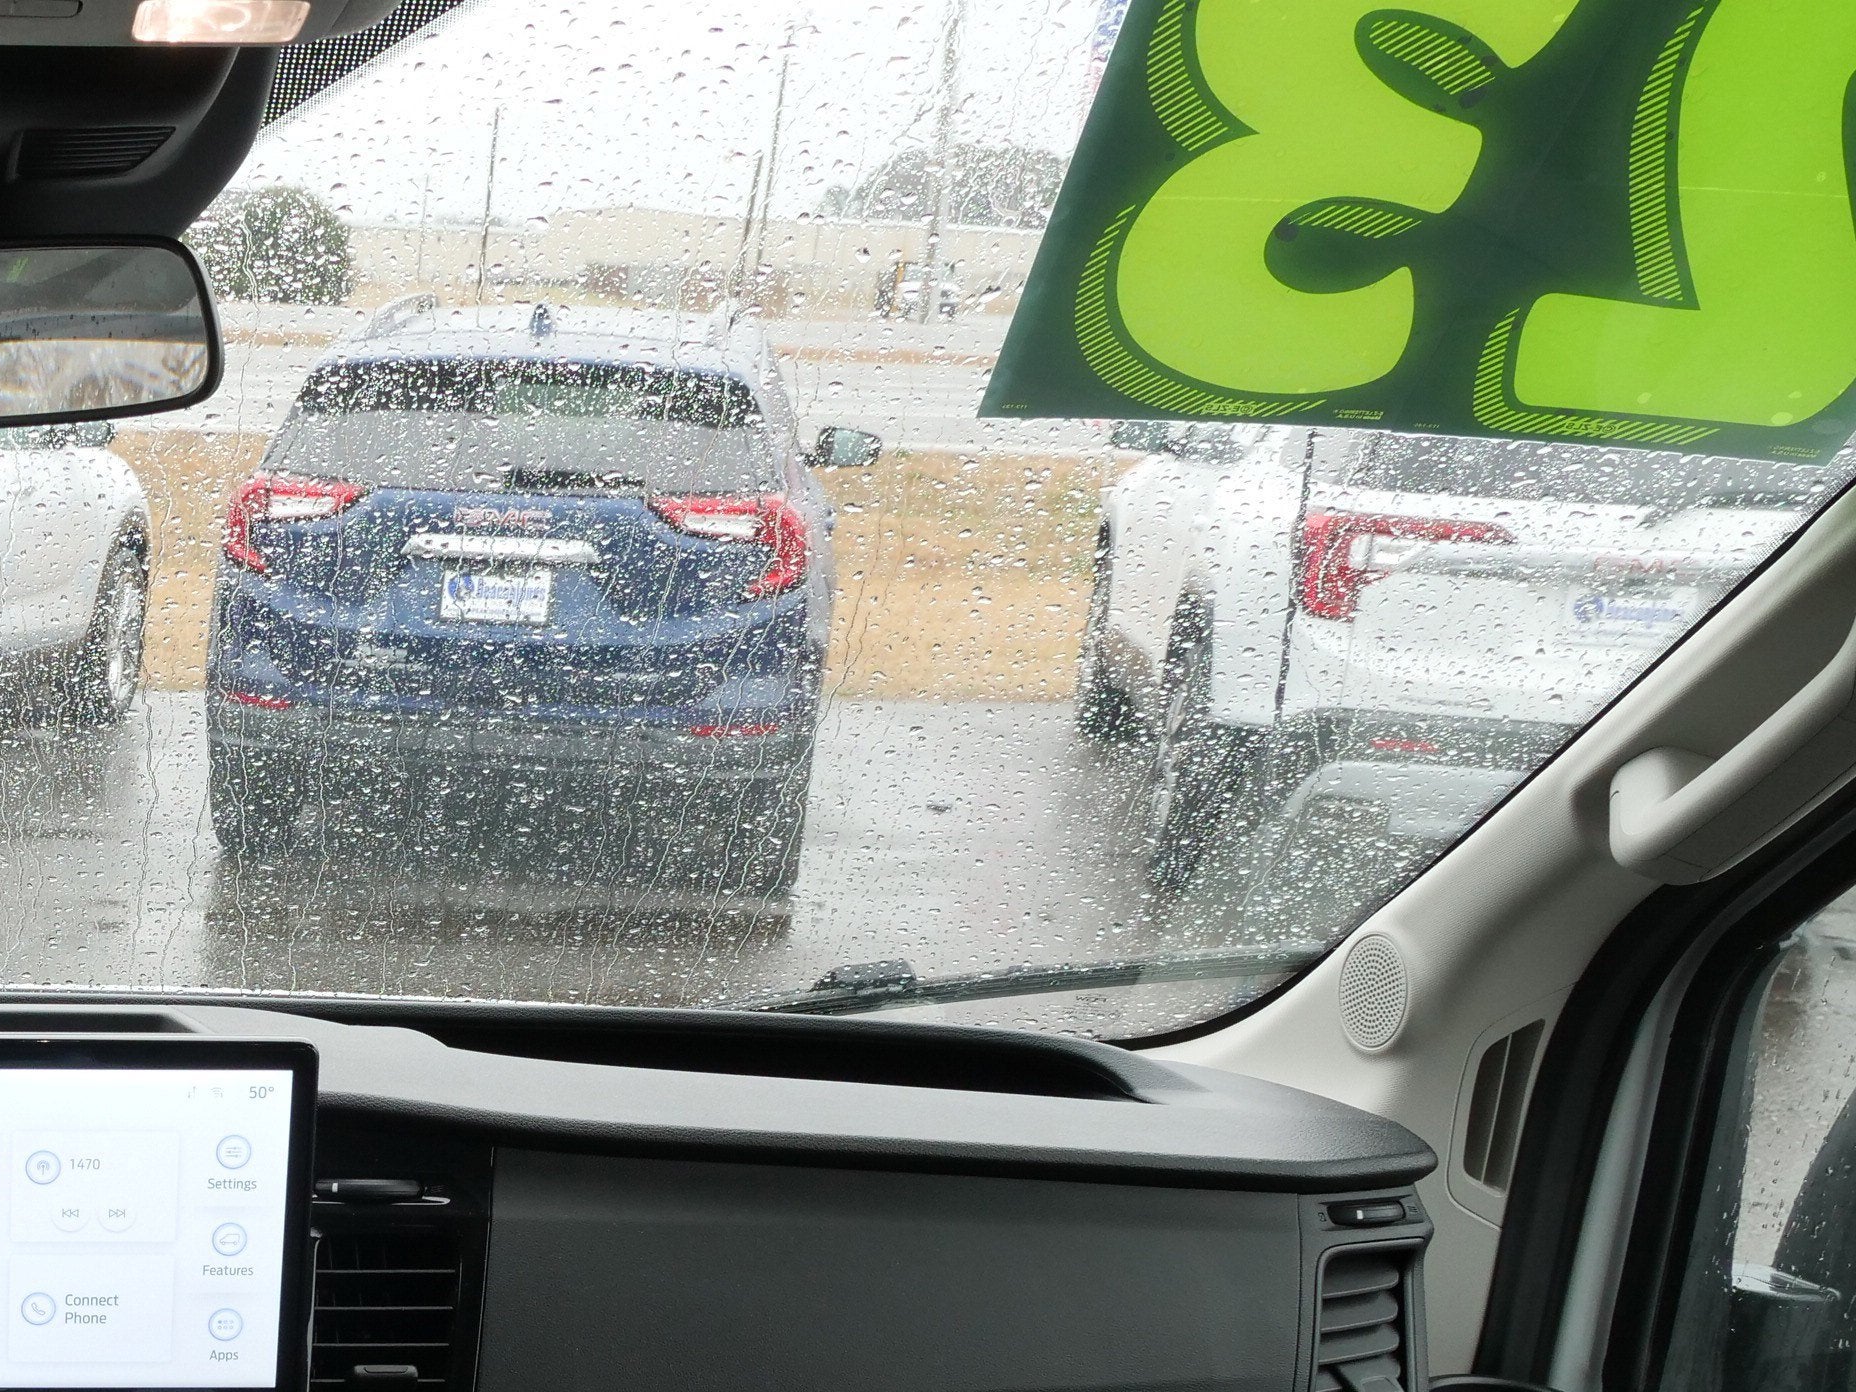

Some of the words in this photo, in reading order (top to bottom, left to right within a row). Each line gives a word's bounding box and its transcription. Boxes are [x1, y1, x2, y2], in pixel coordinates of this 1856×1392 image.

[248, 1085, 275, 1099] 50°
[69, 1158, 101, 1171] 1470
[207, 1177, 258, 1192] Settings
[202, 1264, 254, 1276] Features
[64, 1293, 119, 1307] Connect
[64, 1311, 107, 1324] Phone
[209, 1349, 239, 1362] Apps
